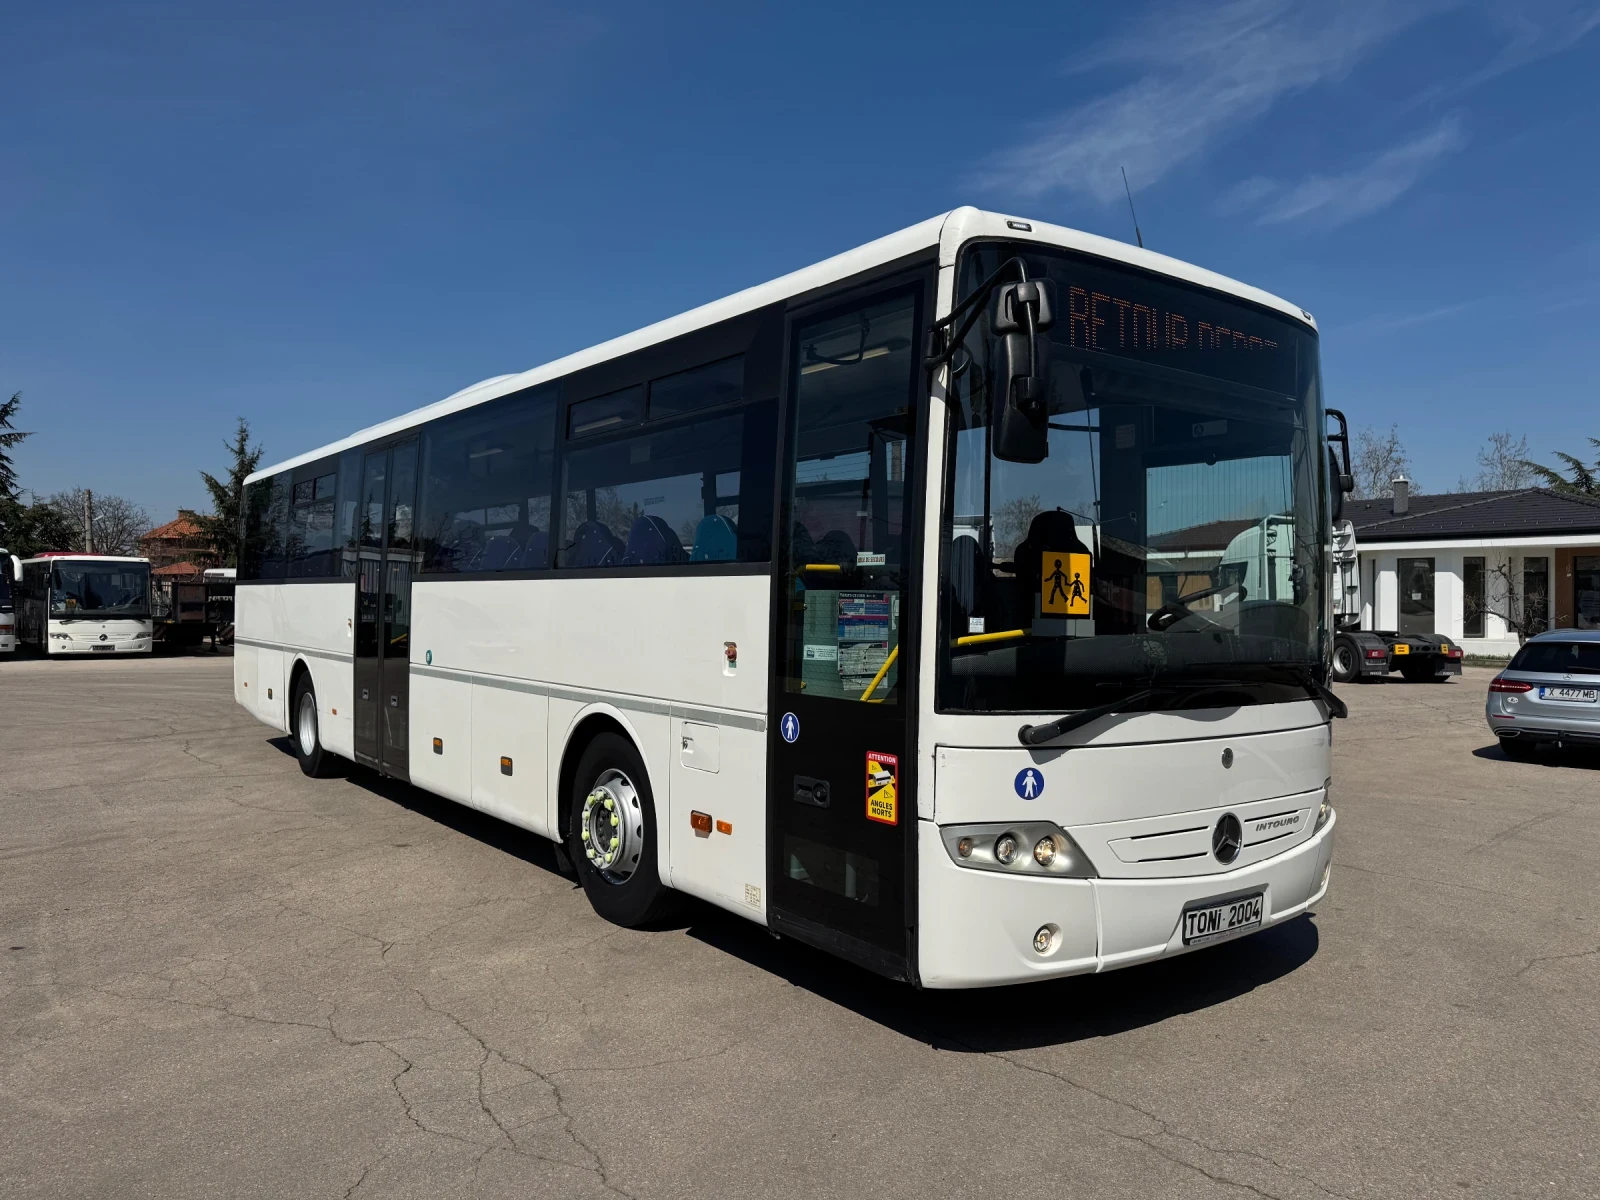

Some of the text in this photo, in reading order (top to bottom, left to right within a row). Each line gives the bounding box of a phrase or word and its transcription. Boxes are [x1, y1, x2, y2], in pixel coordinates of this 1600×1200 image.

[1559, 688, 1582, 698] 4477
[1582, 690, 1595, 699] MB
[868, 753, 896, 763] ATTENTION
[870, 799, 893, 811] ANGLES
[871, 807, 892, 818] MORTS
[1255, 815, 1300, 832] INTOURO
[1228, 899, 1260, 928] 2004
